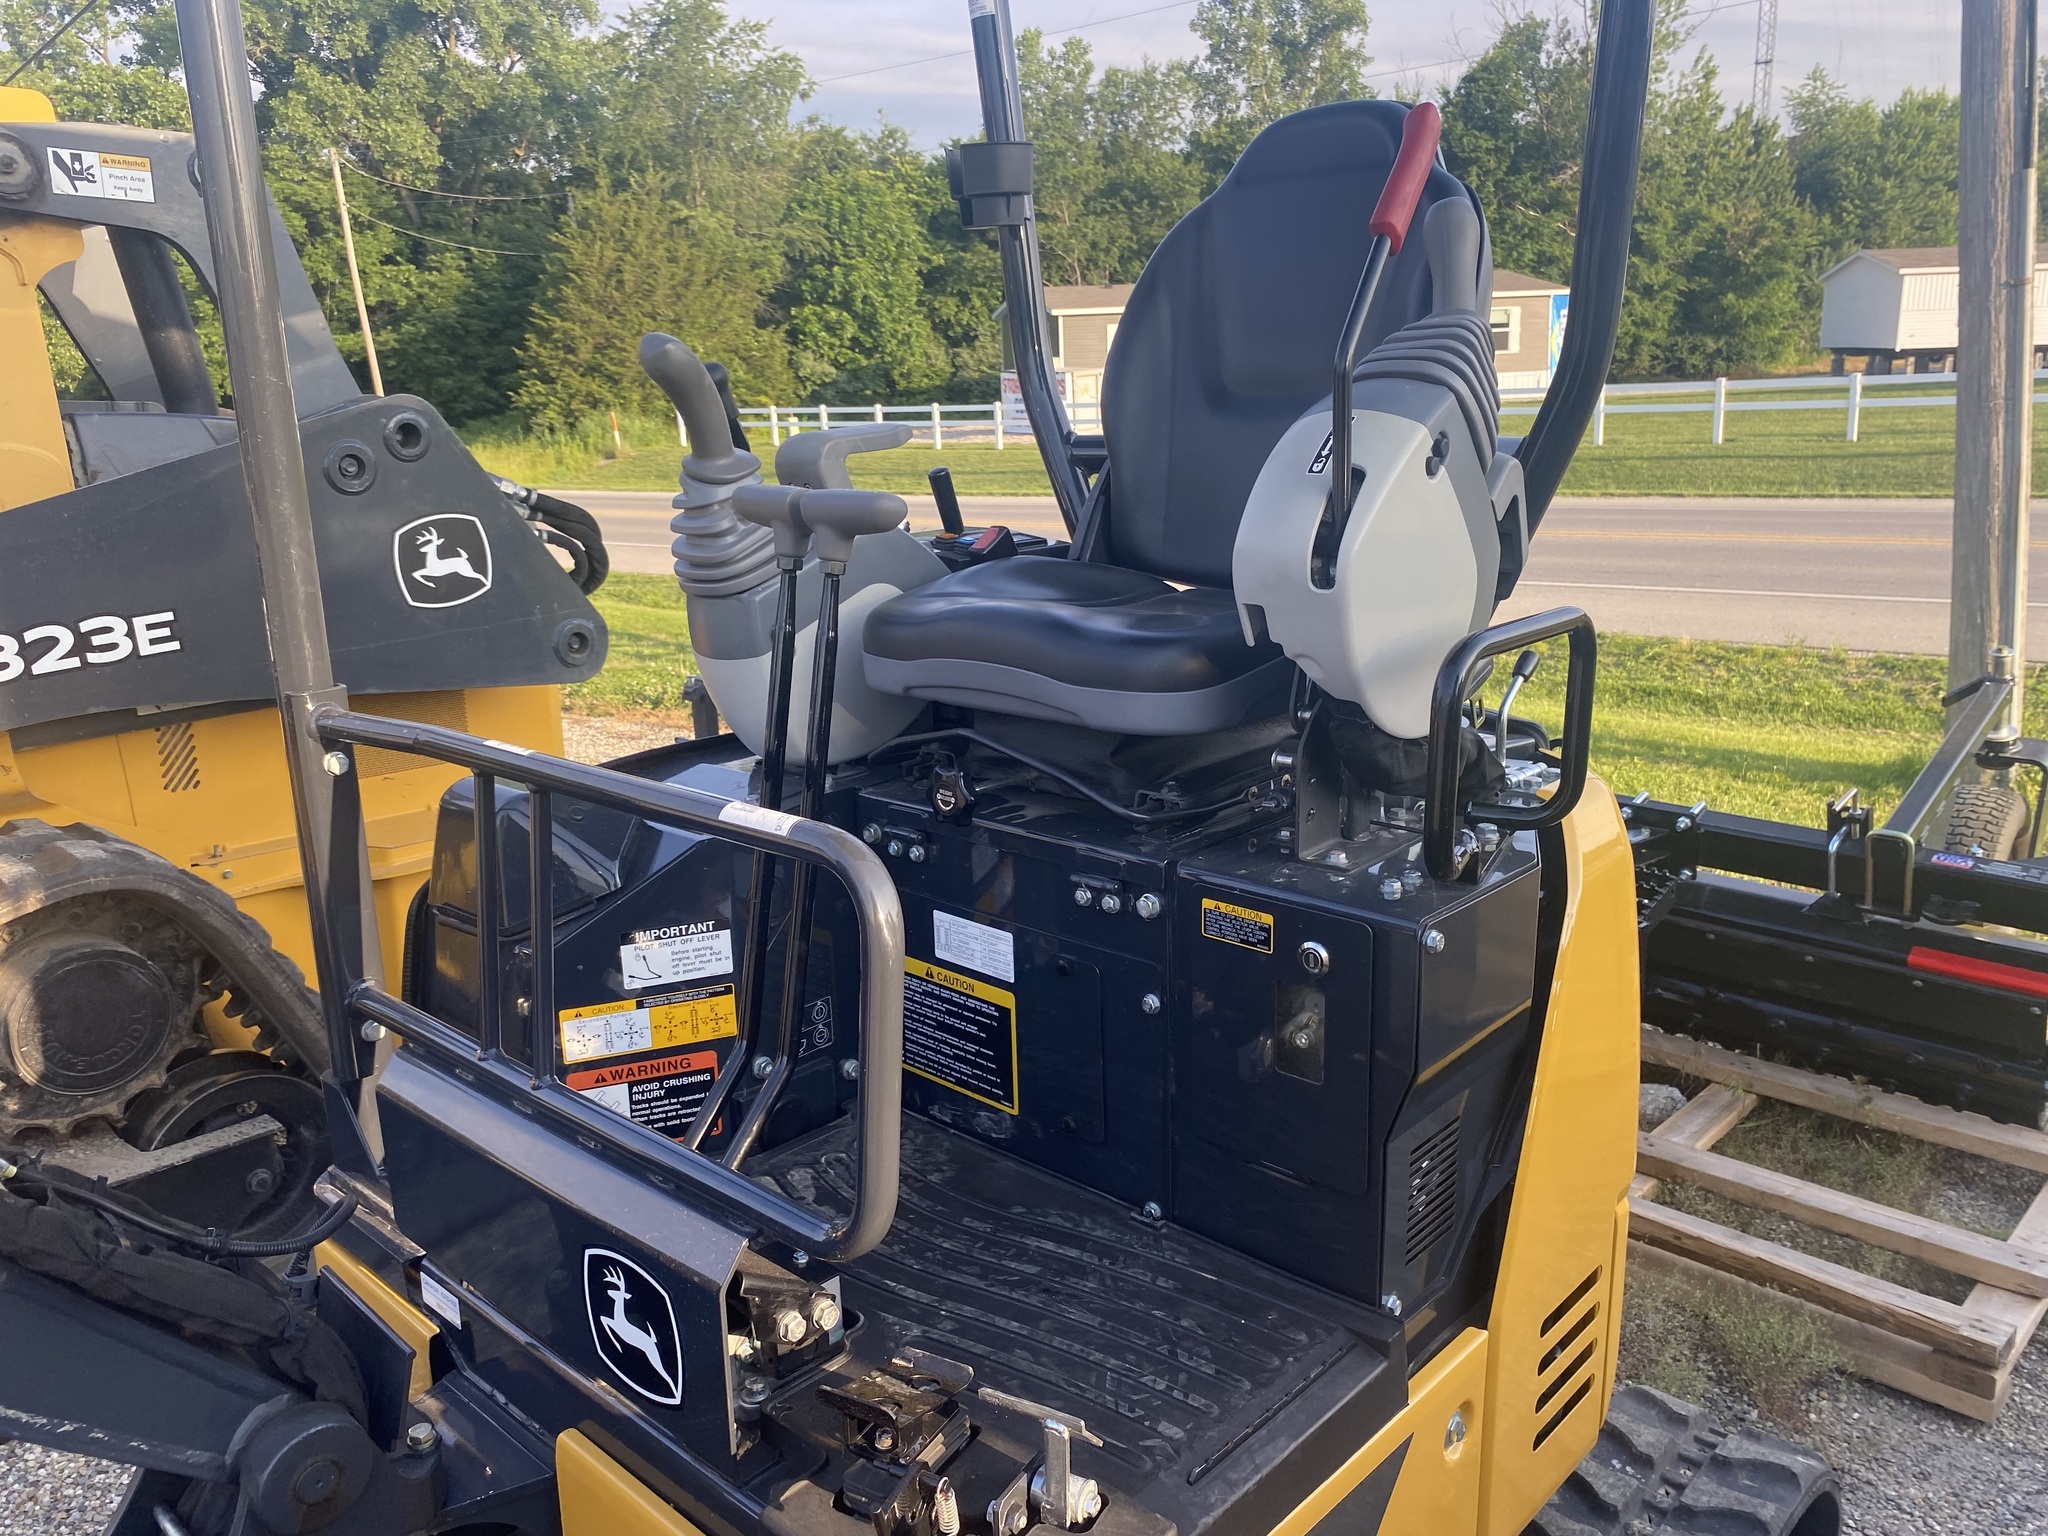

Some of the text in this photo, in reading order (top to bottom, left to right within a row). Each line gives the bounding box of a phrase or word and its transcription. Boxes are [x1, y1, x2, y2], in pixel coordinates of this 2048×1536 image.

[110, 158, 146, 168] WARNING
[109, 173, 145, 183] Pinch Area
[1225, 905, 1262, 921] CAUTION
[635, 920, 715, 943] IMPORTANT
[634, 933, 720, 952] PILOT SHUT OFF LEVER
[692, 945, 713, 953] starting
[937, 971, 975, 993] CAUTION
[693, 999, 713, 1007] Pattern
[592, 1004, 624, 1015] CAUTION
[610, 1012, 632, 1020] Pattern
[610, 1057, 691, 1081] WARNING
[632, 1073, 711, 1093] AVOID CRUSHING
[632, 1090, 666, 1101] INJURY
[631, 1102, 649, 1110] Tracks
[651, 1099, 669, 1107] should
[679, 1093, 705, 1103] expanded
[652, 1104, 682, 1113] operations.
[649, 1112, 666, 1120] tracks
